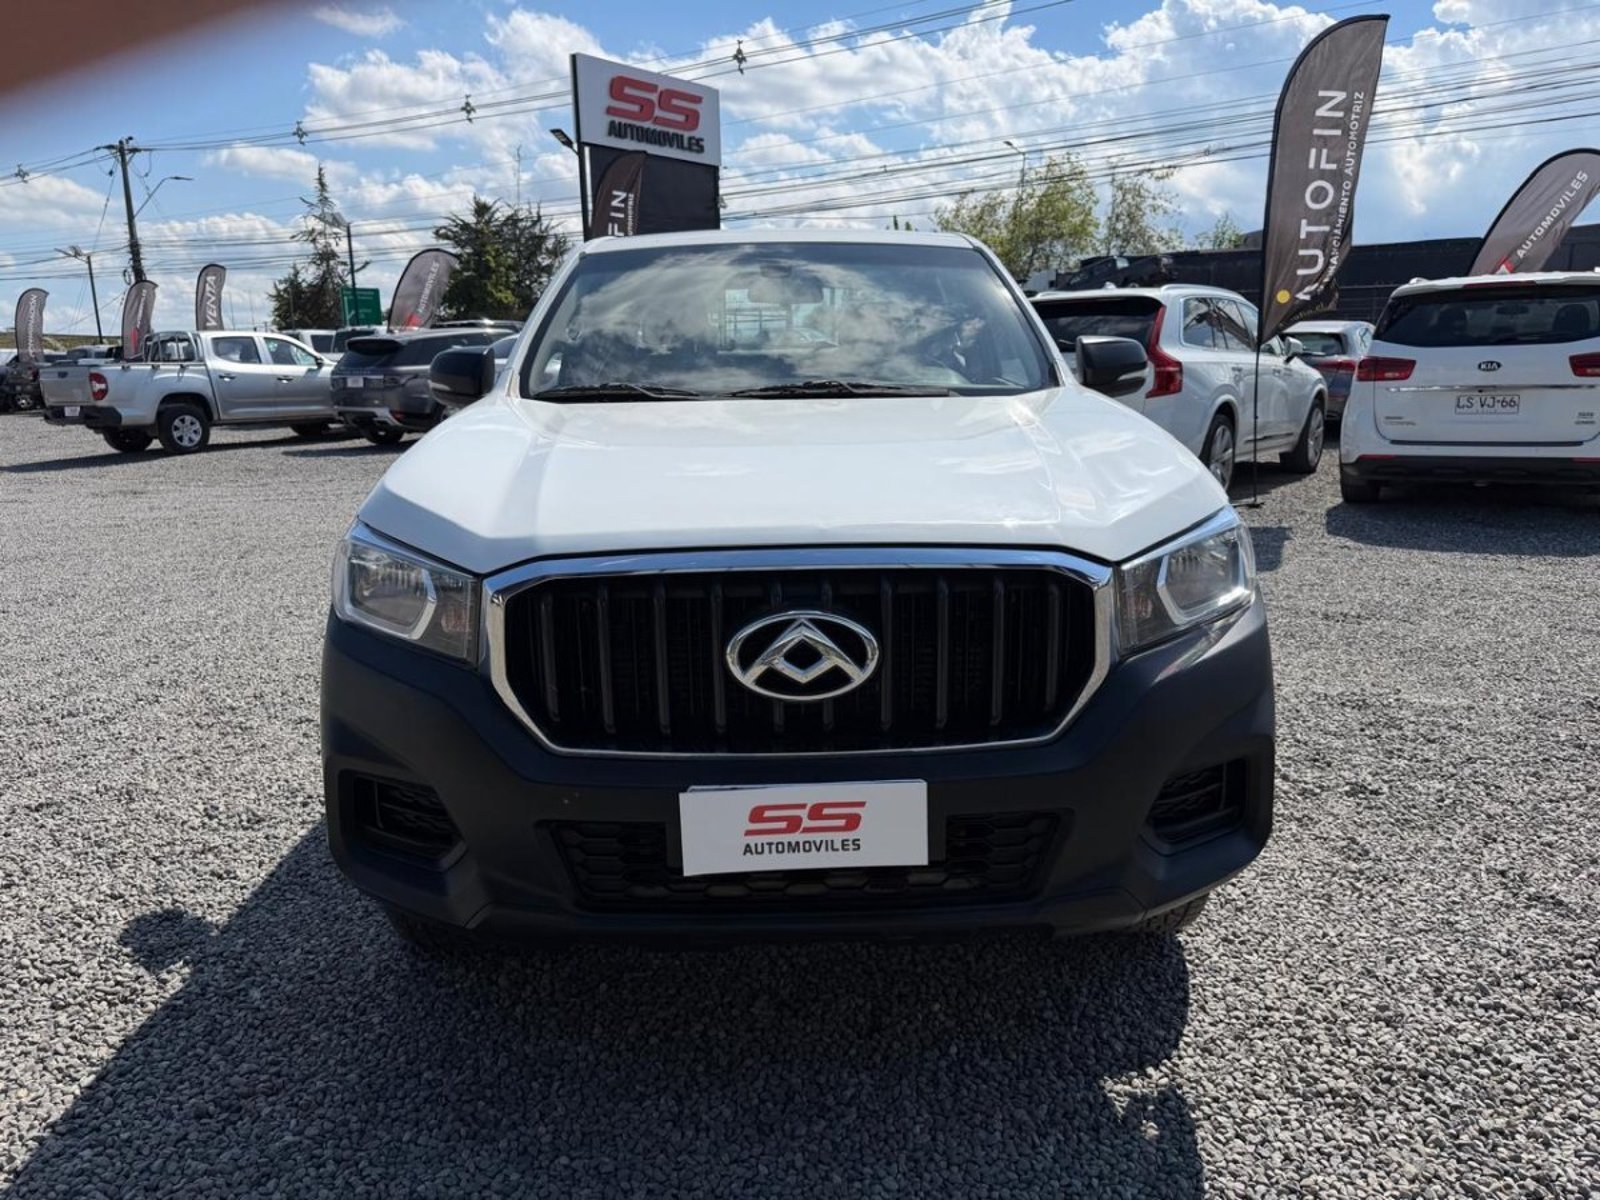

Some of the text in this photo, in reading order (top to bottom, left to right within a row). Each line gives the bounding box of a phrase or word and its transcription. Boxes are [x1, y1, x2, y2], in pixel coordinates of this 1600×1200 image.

[606, 75, 703, 132] SS
[607, 120, 705, 153] AUTOMOVILES
[1344, 91, 1364, 177] AUTOMOTRIZ
[1295, 90, 1347, 300] AUTOFIN
[1516, 170, 1588, 259] AUTOMOVILES
[205, 276, 218, 327] VENTA
[1479, 361, 1500, 371] KIA
[744, 801, 867, 837] SS
[743, 838, 862, 856] AUTOMOVILES
